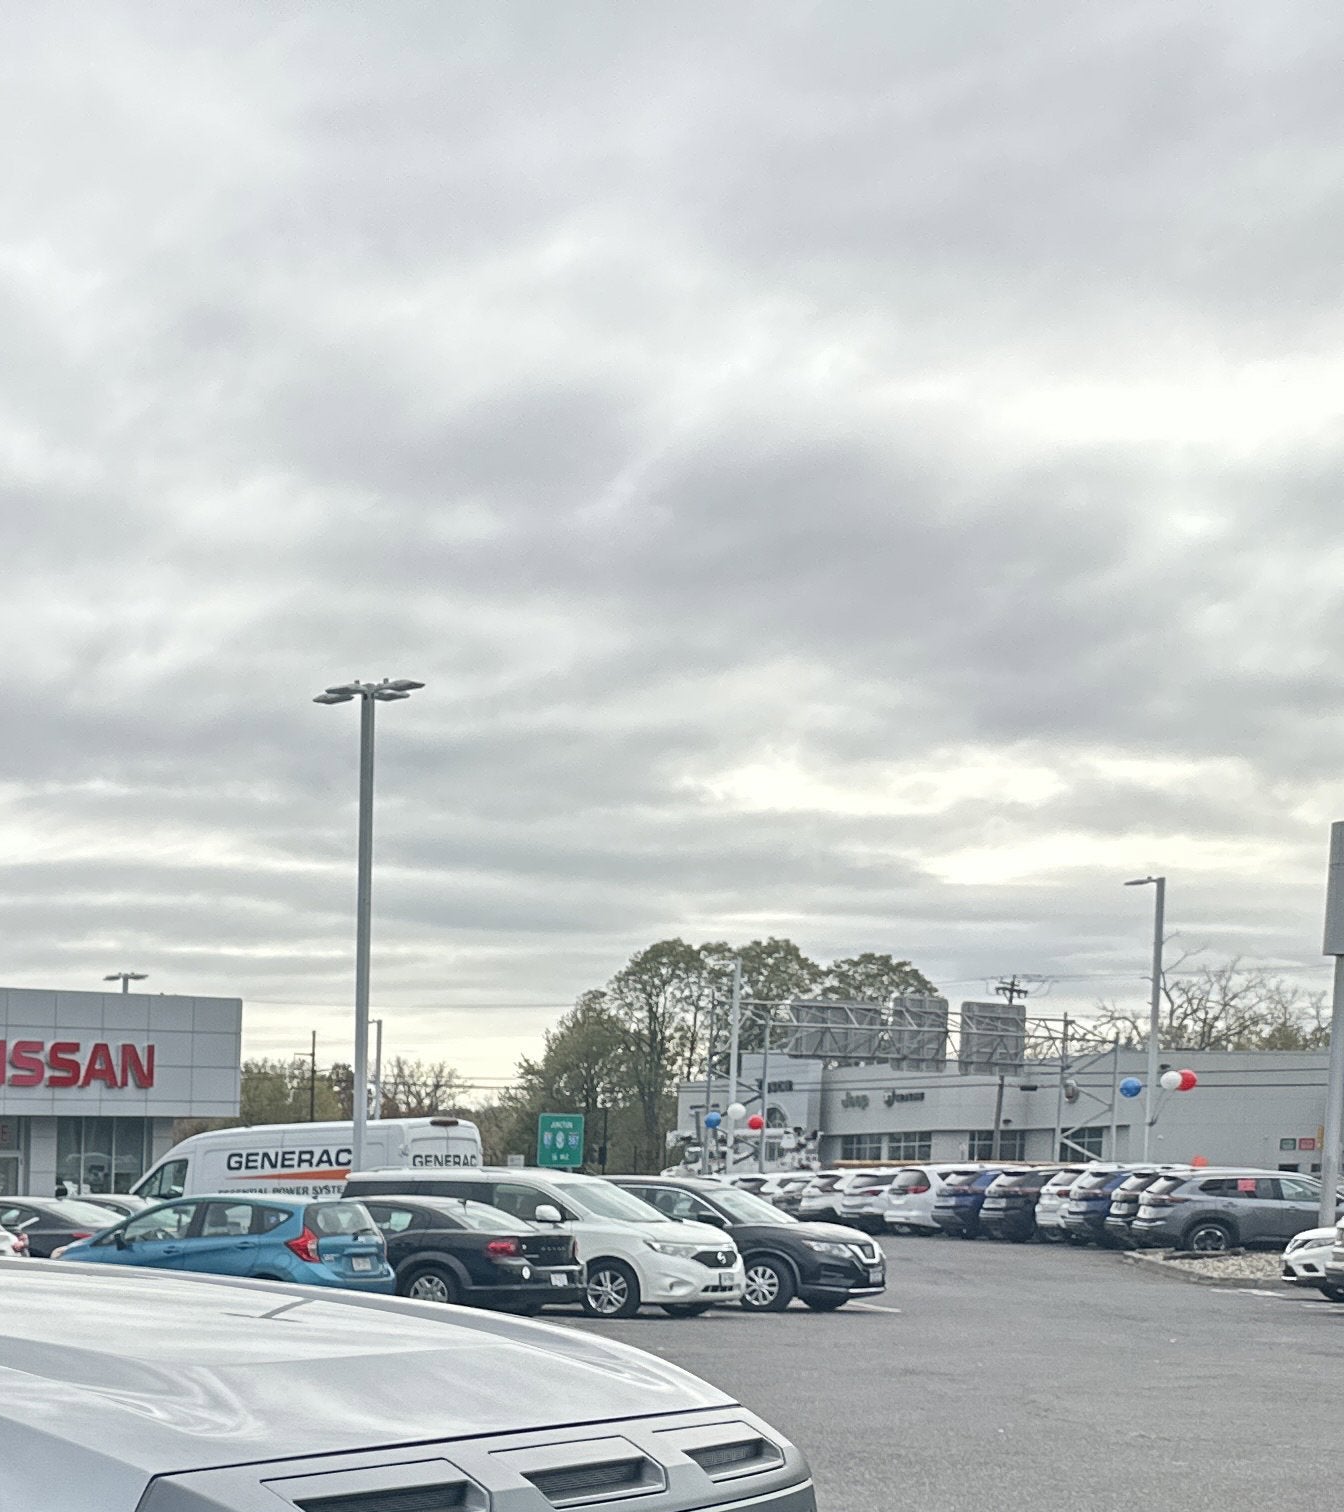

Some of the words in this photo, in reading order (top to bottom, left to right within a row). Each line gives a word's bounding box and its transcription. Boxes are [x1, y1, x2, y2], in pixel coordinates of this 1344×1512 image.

[226, 1148, 352, 1171] GENERAC
[412, 1154, 477, 1167] GENERAC
[272, 1185, 309, 1196] POWER
[311, 1184, 344, 1196] SYSTE
